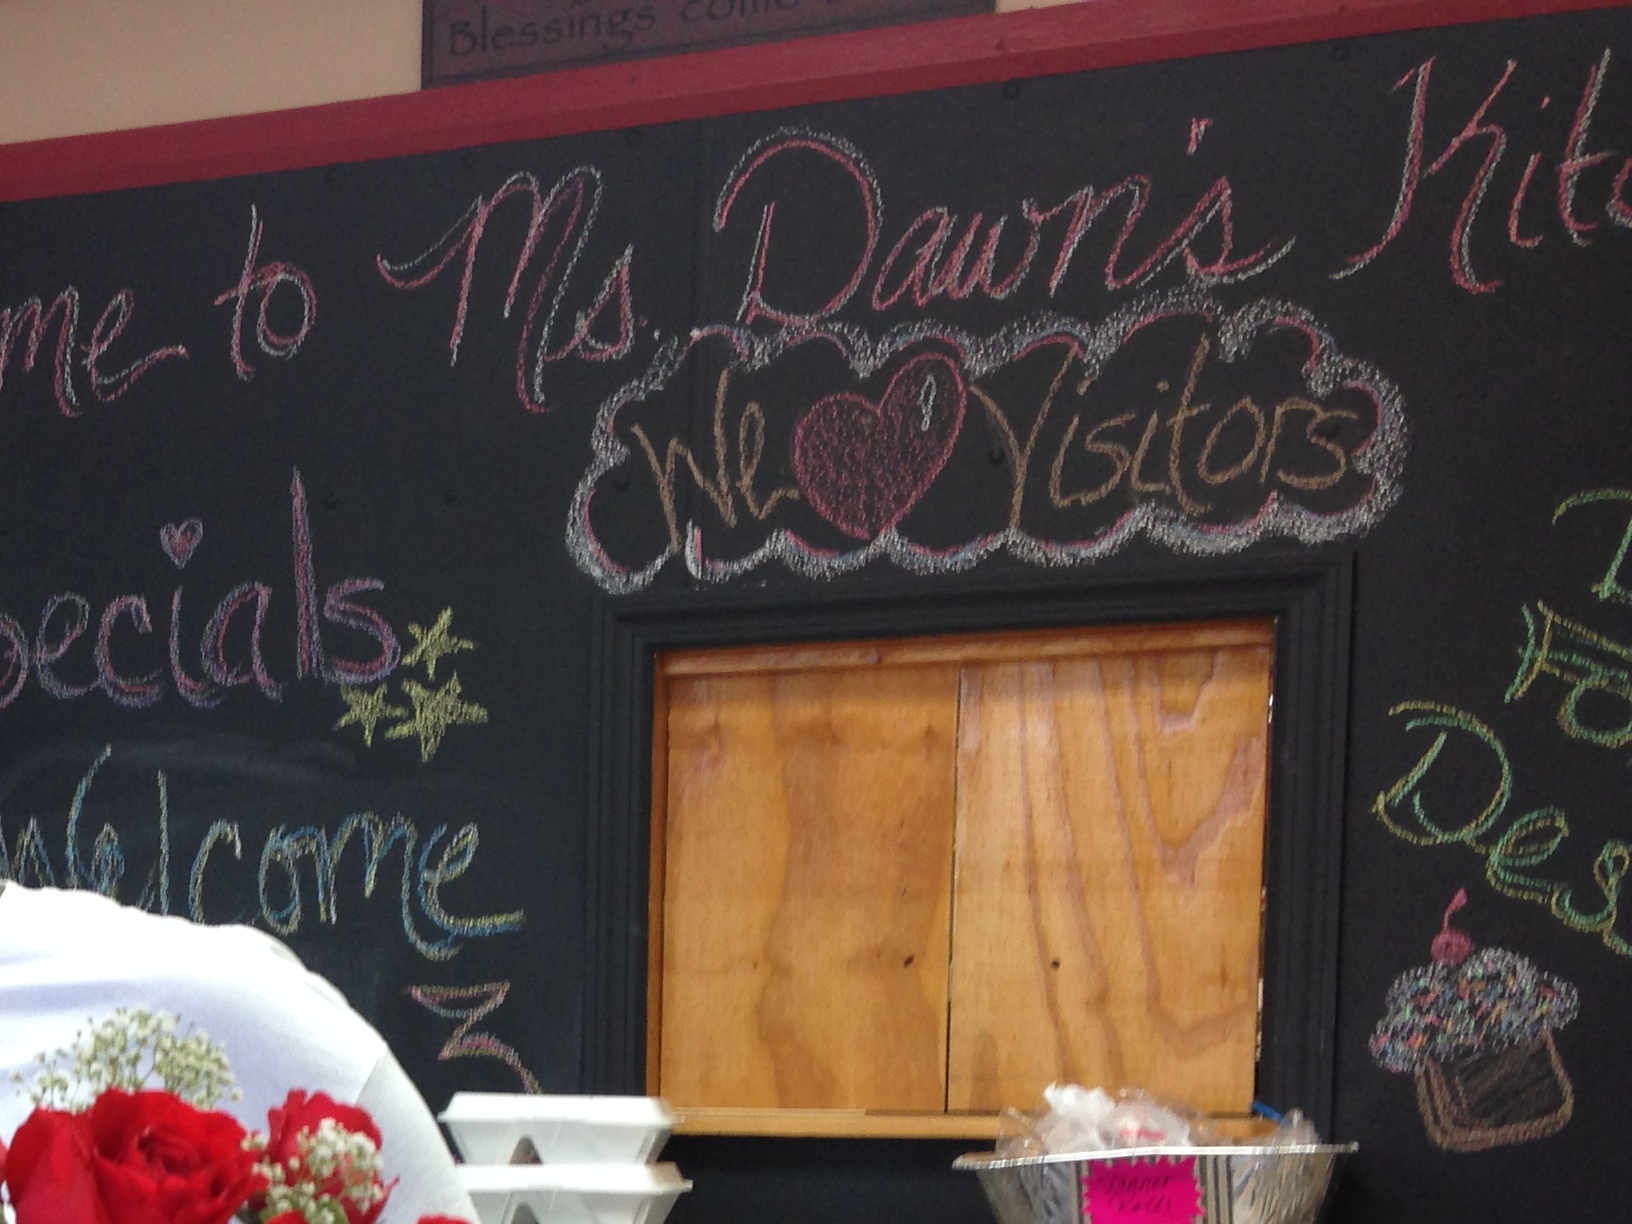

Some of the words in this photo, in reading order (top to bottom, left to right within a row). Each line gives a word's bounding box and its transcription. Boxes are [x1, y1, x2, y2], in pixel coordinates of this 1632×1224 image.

[449, 4, 657, 57] Blessings
[215, 204, 317, 381] to
[376, 165, 662, 412] Ms.
[713, 117, 1296, 326] Dawn's
[630, 366, 801, 554] We
[969, 333, 1356, 533] Visitors
